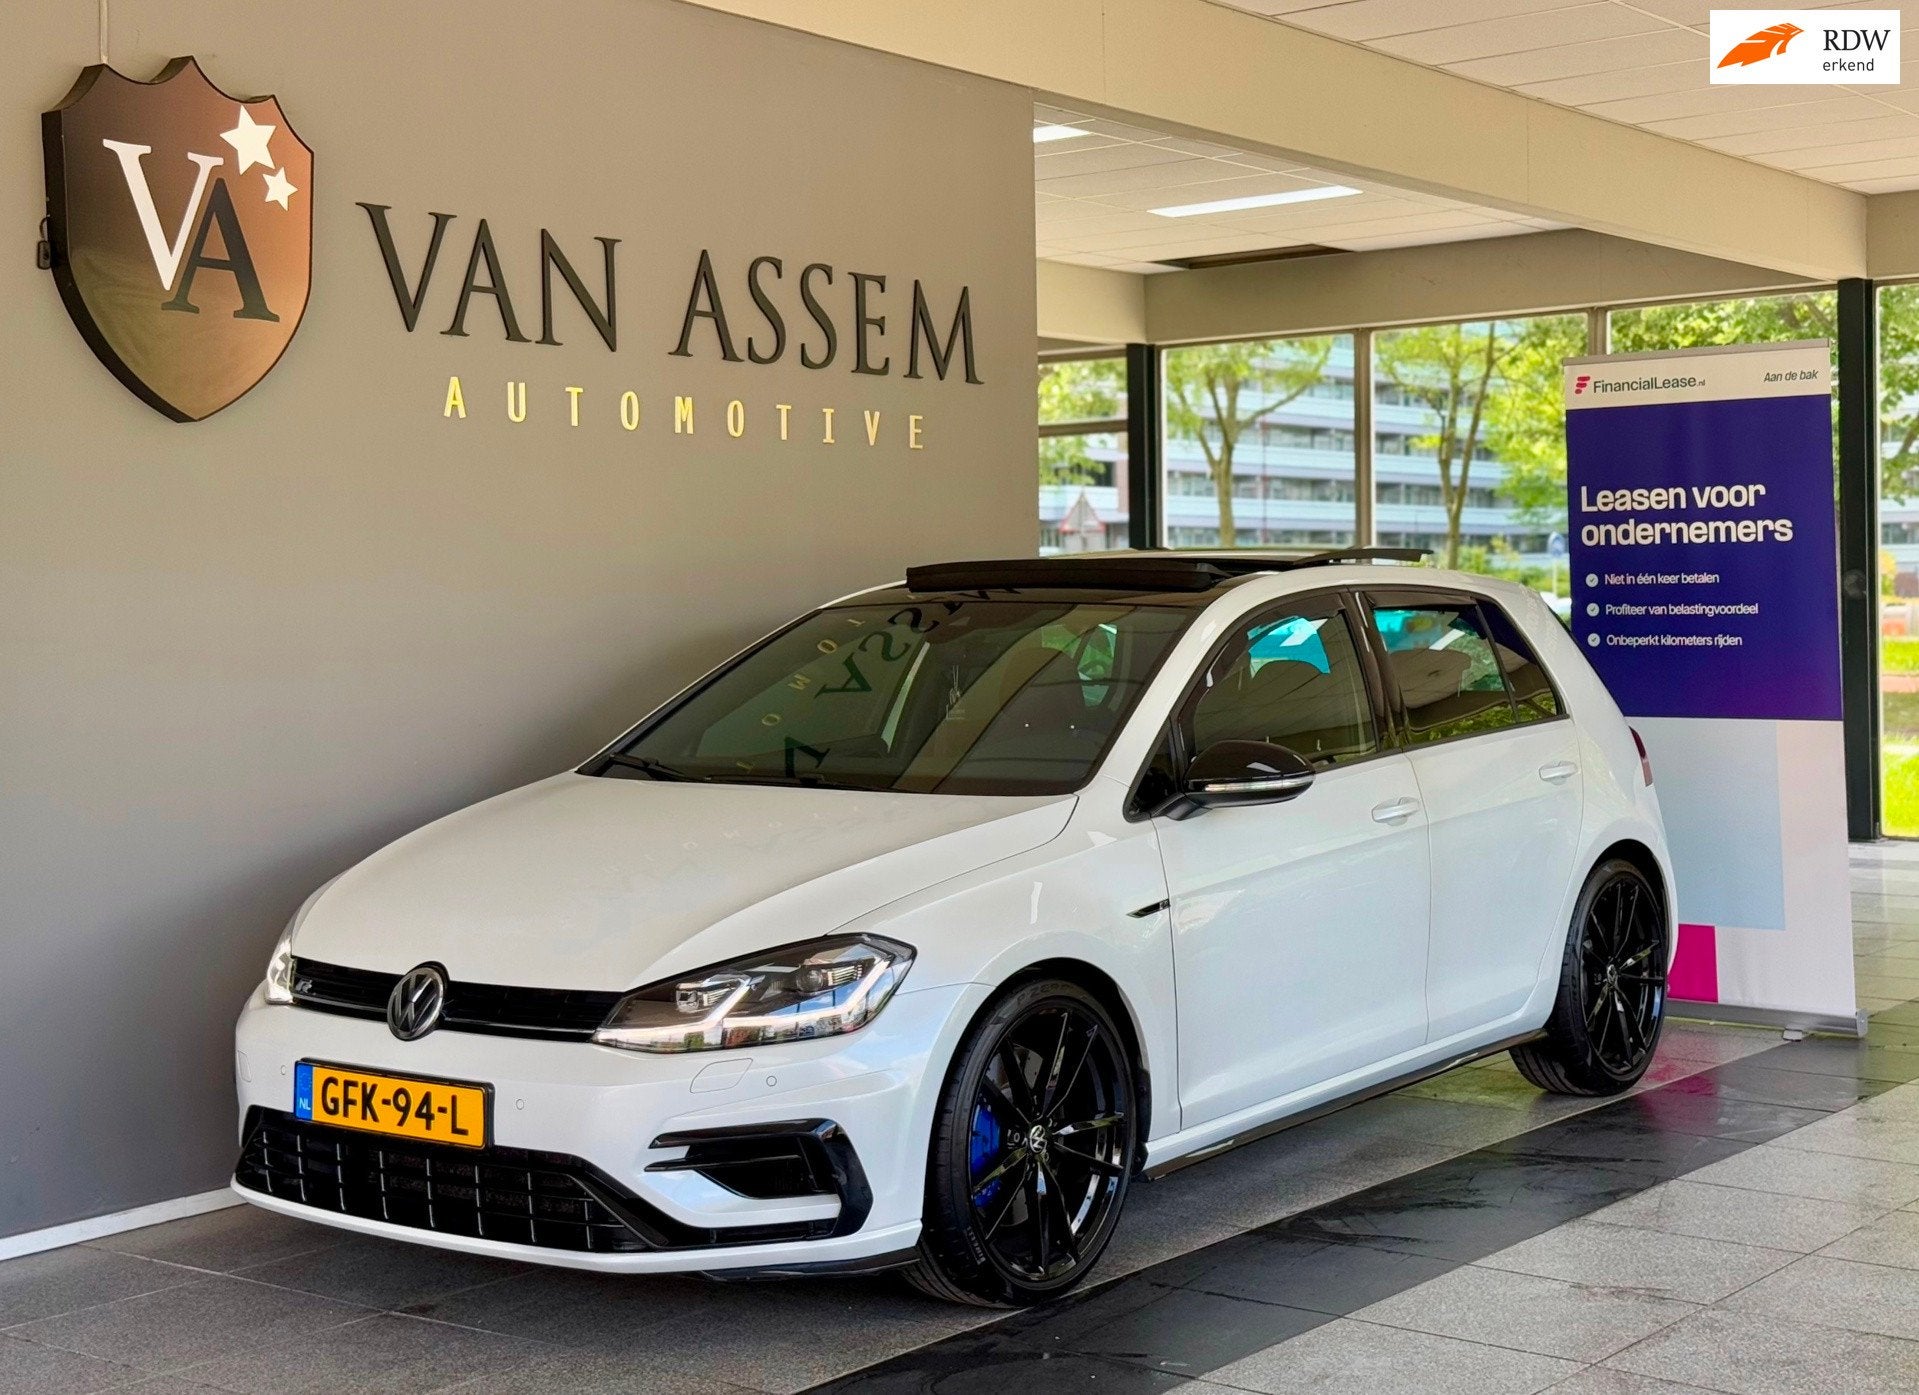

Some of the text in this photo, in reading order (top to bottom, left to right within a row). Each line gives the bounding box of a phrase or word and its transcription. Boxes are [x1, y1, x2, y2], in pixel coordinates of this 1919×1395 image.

[355, 202, 985, 385] VAN ASSEM
[1763, 369, 1819, 382] Aan de bak
[443, 376, 924, 449] AUTOMOTIVE
[1580, 484, 1766, 512] Leasen voor
[1581, 518, 1793, 547] ondernemers
[1604, 572, 1720, 585] Niet in één keer betalen
[1605, 603, 1759, 617] Profiteer van belastingvoordeel
[1606, 634, 1743, 648] Onbeperkt kilometers rijden
[300, 1097, 312, 1111] NL
[321, 1076, 469, 1136] GFK-94-L
